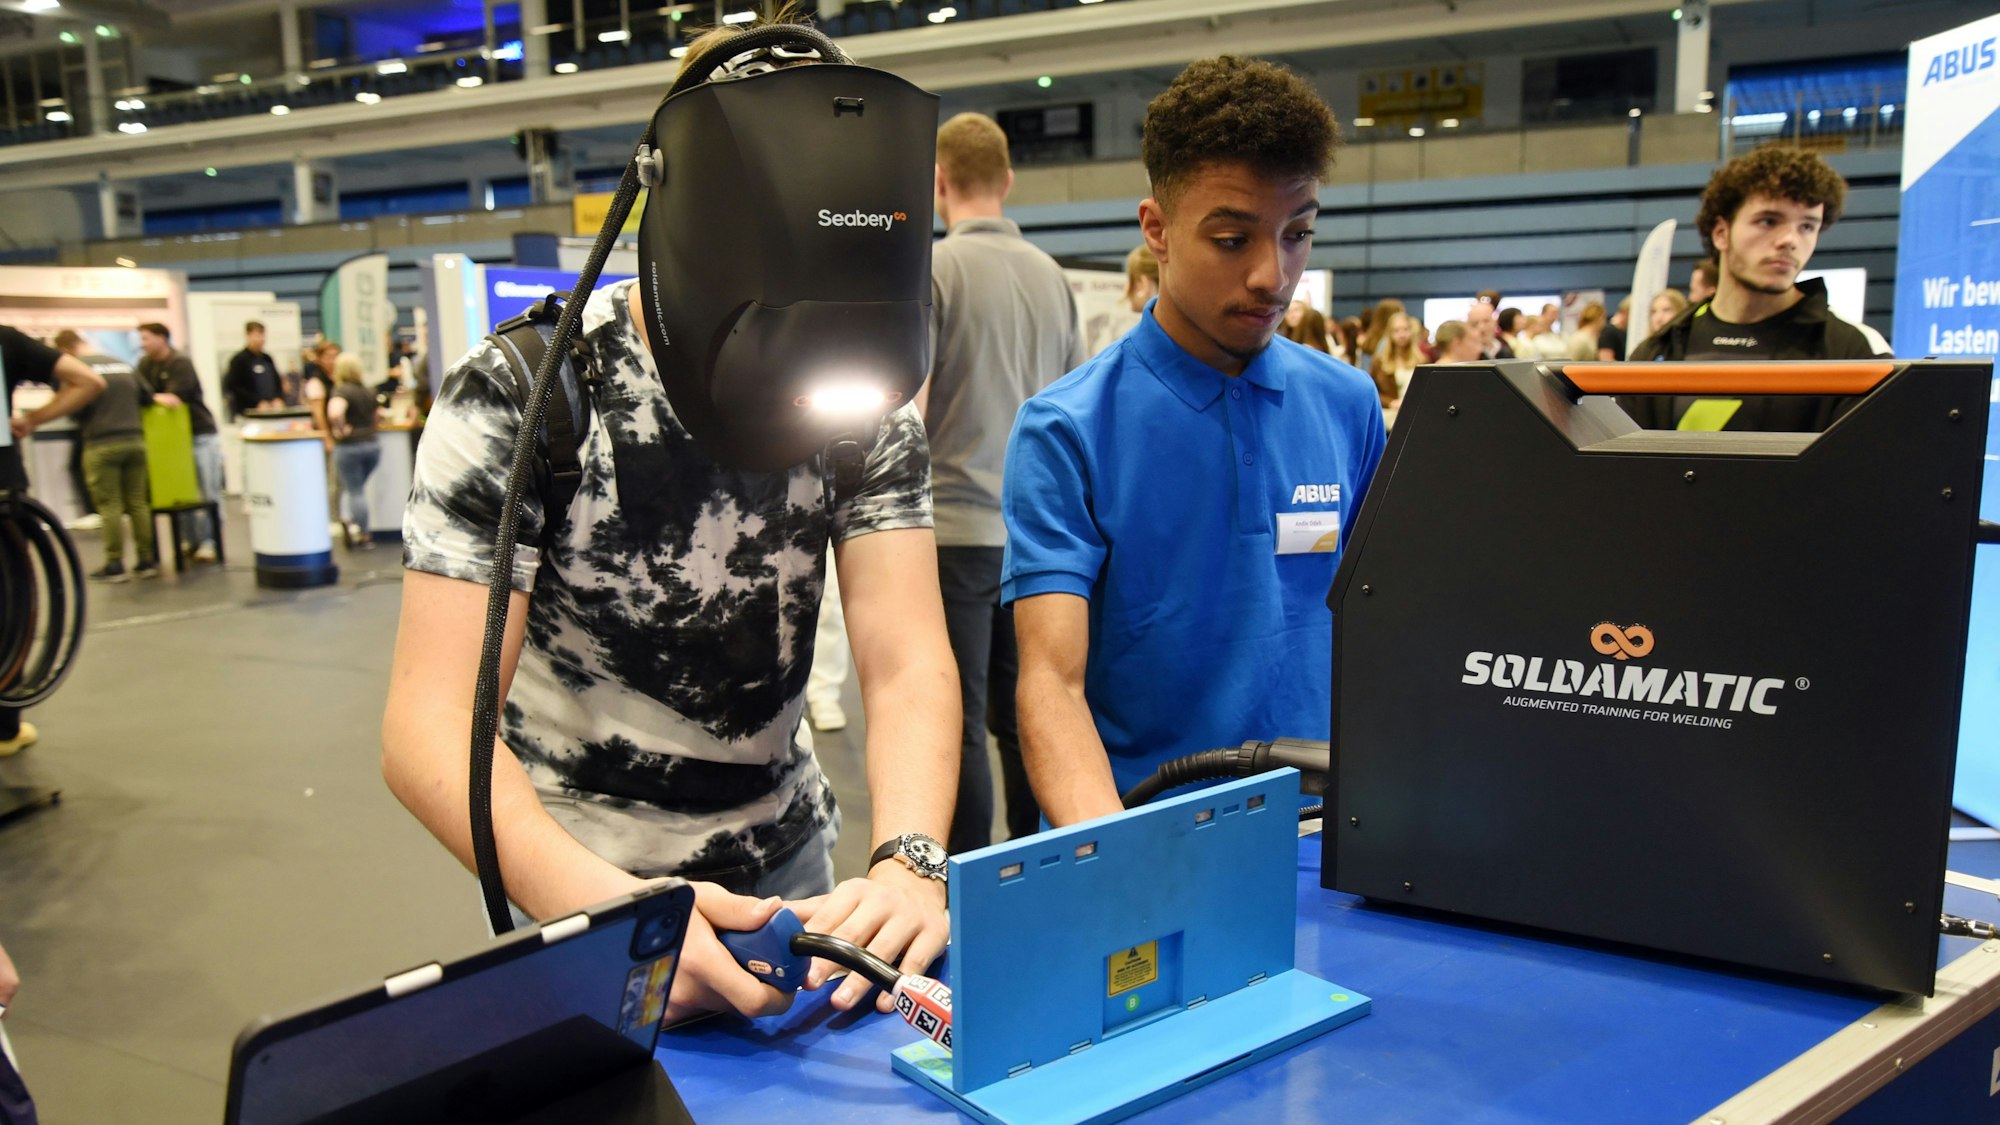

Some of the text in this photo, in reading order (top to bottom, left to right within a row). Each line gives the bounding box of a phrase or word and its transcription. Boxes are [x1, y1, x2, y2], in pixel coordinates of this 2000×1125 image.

[1923, 36, 1998, 87] ABUS
[818, 209, 893, 231] Seabery
[651, 261, 670, 345] soldamatic.com
[1923, 275, 1959, 309] Wir
[1929, 323, 1999, 354] Lasten
[1291, 484, 1341, 504] ABUS
[1461, 651, 1785, 715] SOLDAMATIC
[1503, 696, 1733, 730] AUGMENTED TRAINING FOR WELDING
